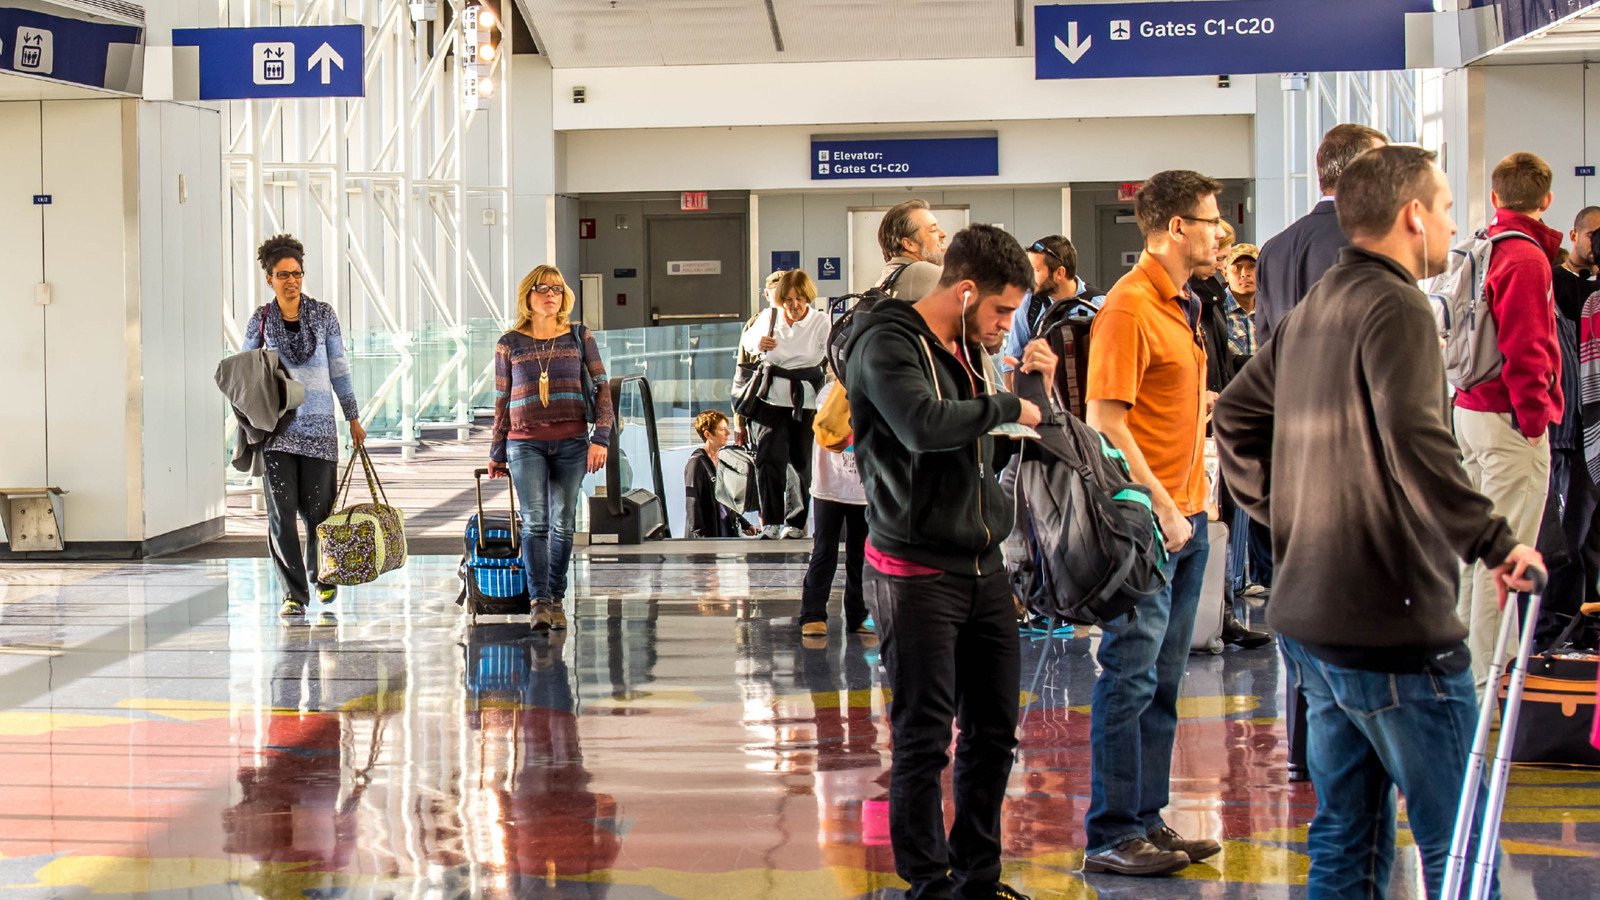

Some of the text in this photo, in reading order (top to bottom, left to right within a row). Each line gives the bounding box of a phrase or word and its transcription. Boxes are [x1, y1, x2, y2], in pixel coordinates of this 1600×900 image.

[1139, 17, 1275, 38] Gates C1-C20
[833, 151, 883, 161] Elevator:
[833, 163, 910, 174] Gates C1-C20
[684, 192, 706, 209] EXIT
